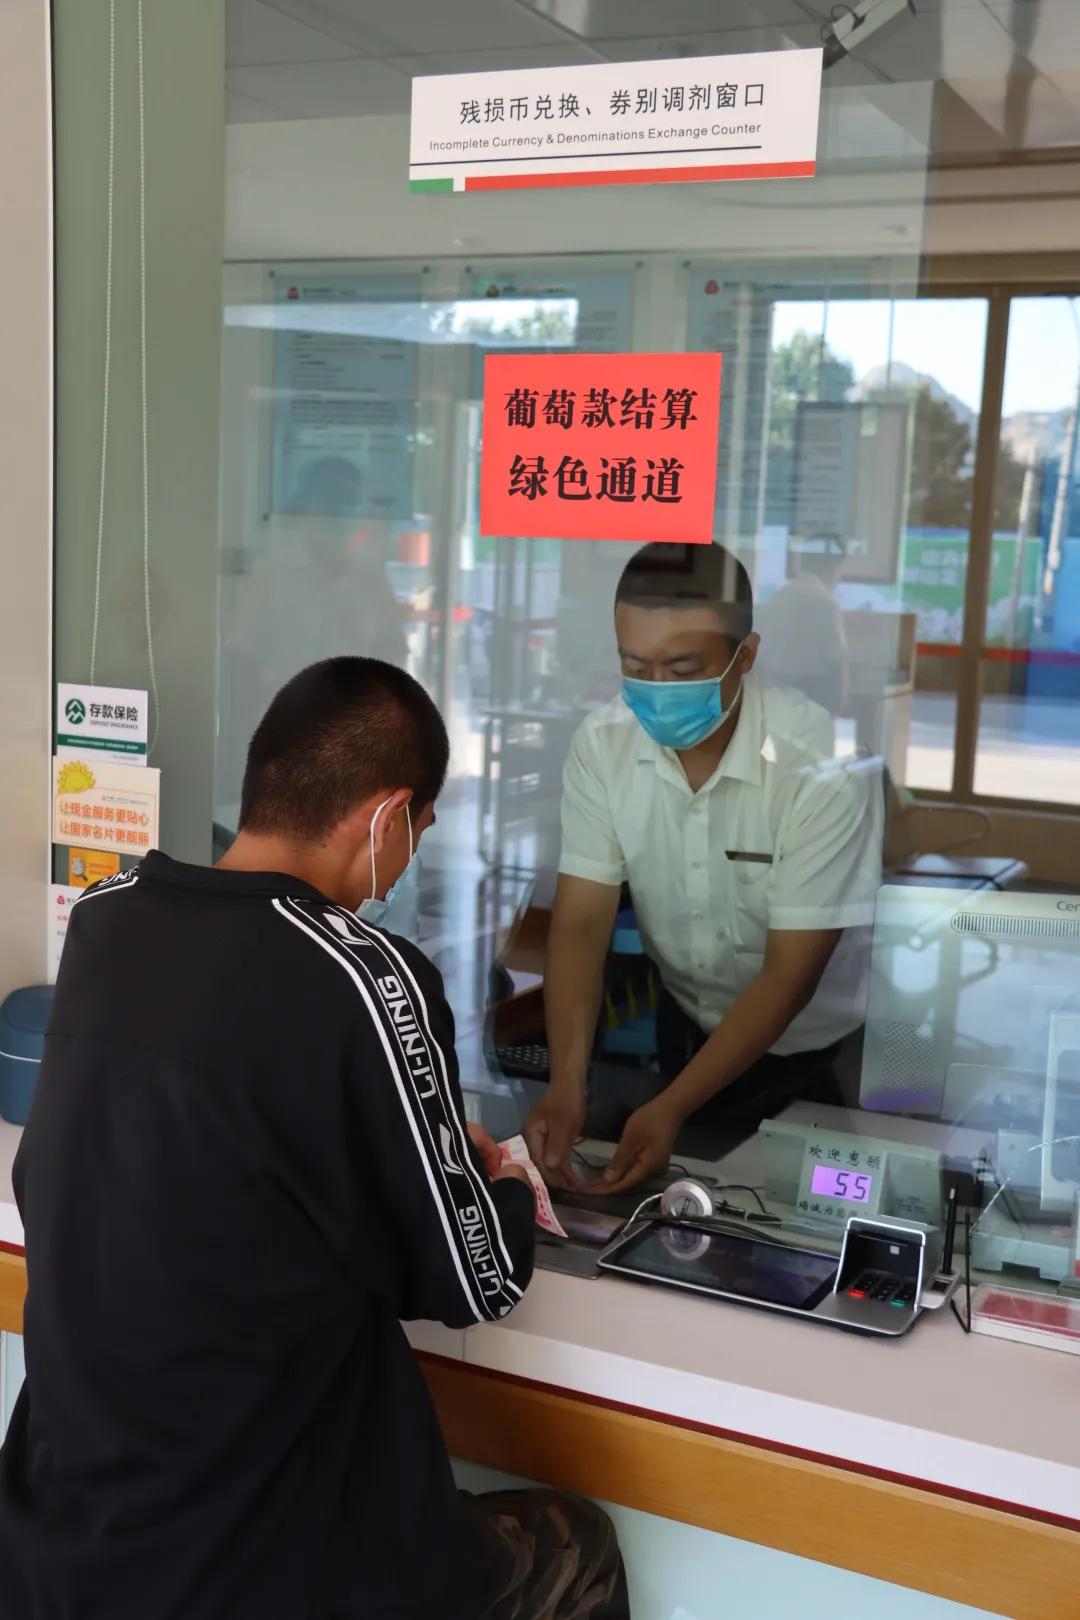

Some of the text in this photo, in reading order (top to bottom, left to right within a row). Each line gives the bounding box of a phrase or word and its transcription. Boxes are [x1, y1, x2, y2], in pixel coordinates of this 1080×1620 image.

[459, 83, 766, 125] 残损币兑换、券别调剂窗口
[429, 123, 762, 151] Incomplete Currency & Denominations Exchange Counter
[504, 387, 698, 430] 葡萄款结算
[508, 454, 685, 504] 绿色通道
[89, 703, 139, 722] 存款保险
[378, 974, 438, 1100] LI-NING
[808, 1143, 881, 1170] 欢迎惠顾
[834, 1172, 868, 1200] 55
[458, 1204, 502, 1297] LI-NING
